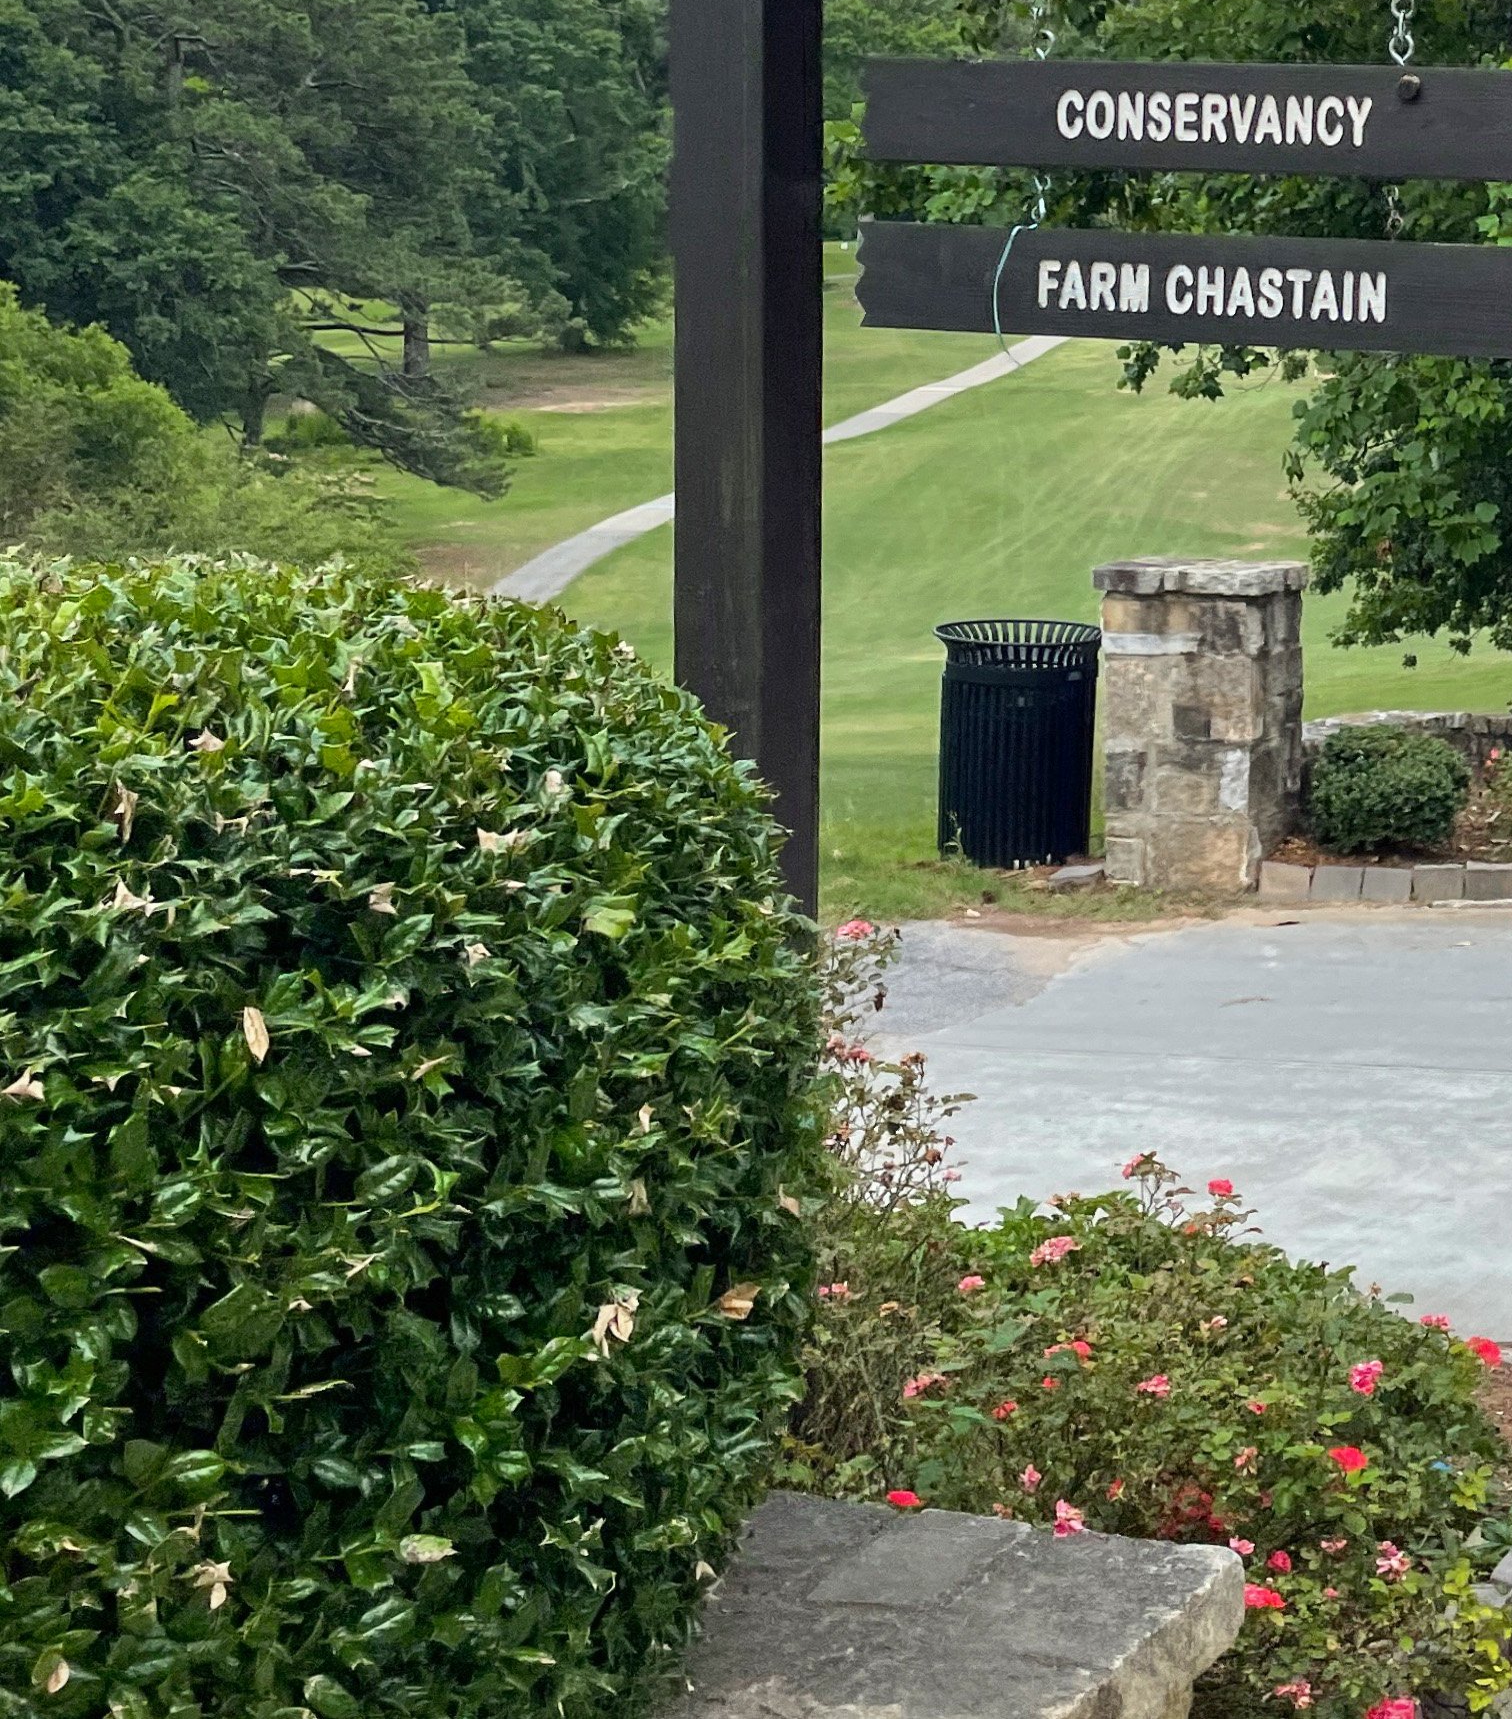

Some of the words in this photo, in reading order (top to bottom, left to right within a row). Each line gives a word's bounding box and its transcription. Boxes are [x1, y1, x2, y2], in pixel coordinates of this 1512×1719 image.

[1057, 90, 1372, 146] CONSERVANCY
[1038, 260, 1149, 312] FARM
[1166, 265, 1386, 323] CHASTAIN
